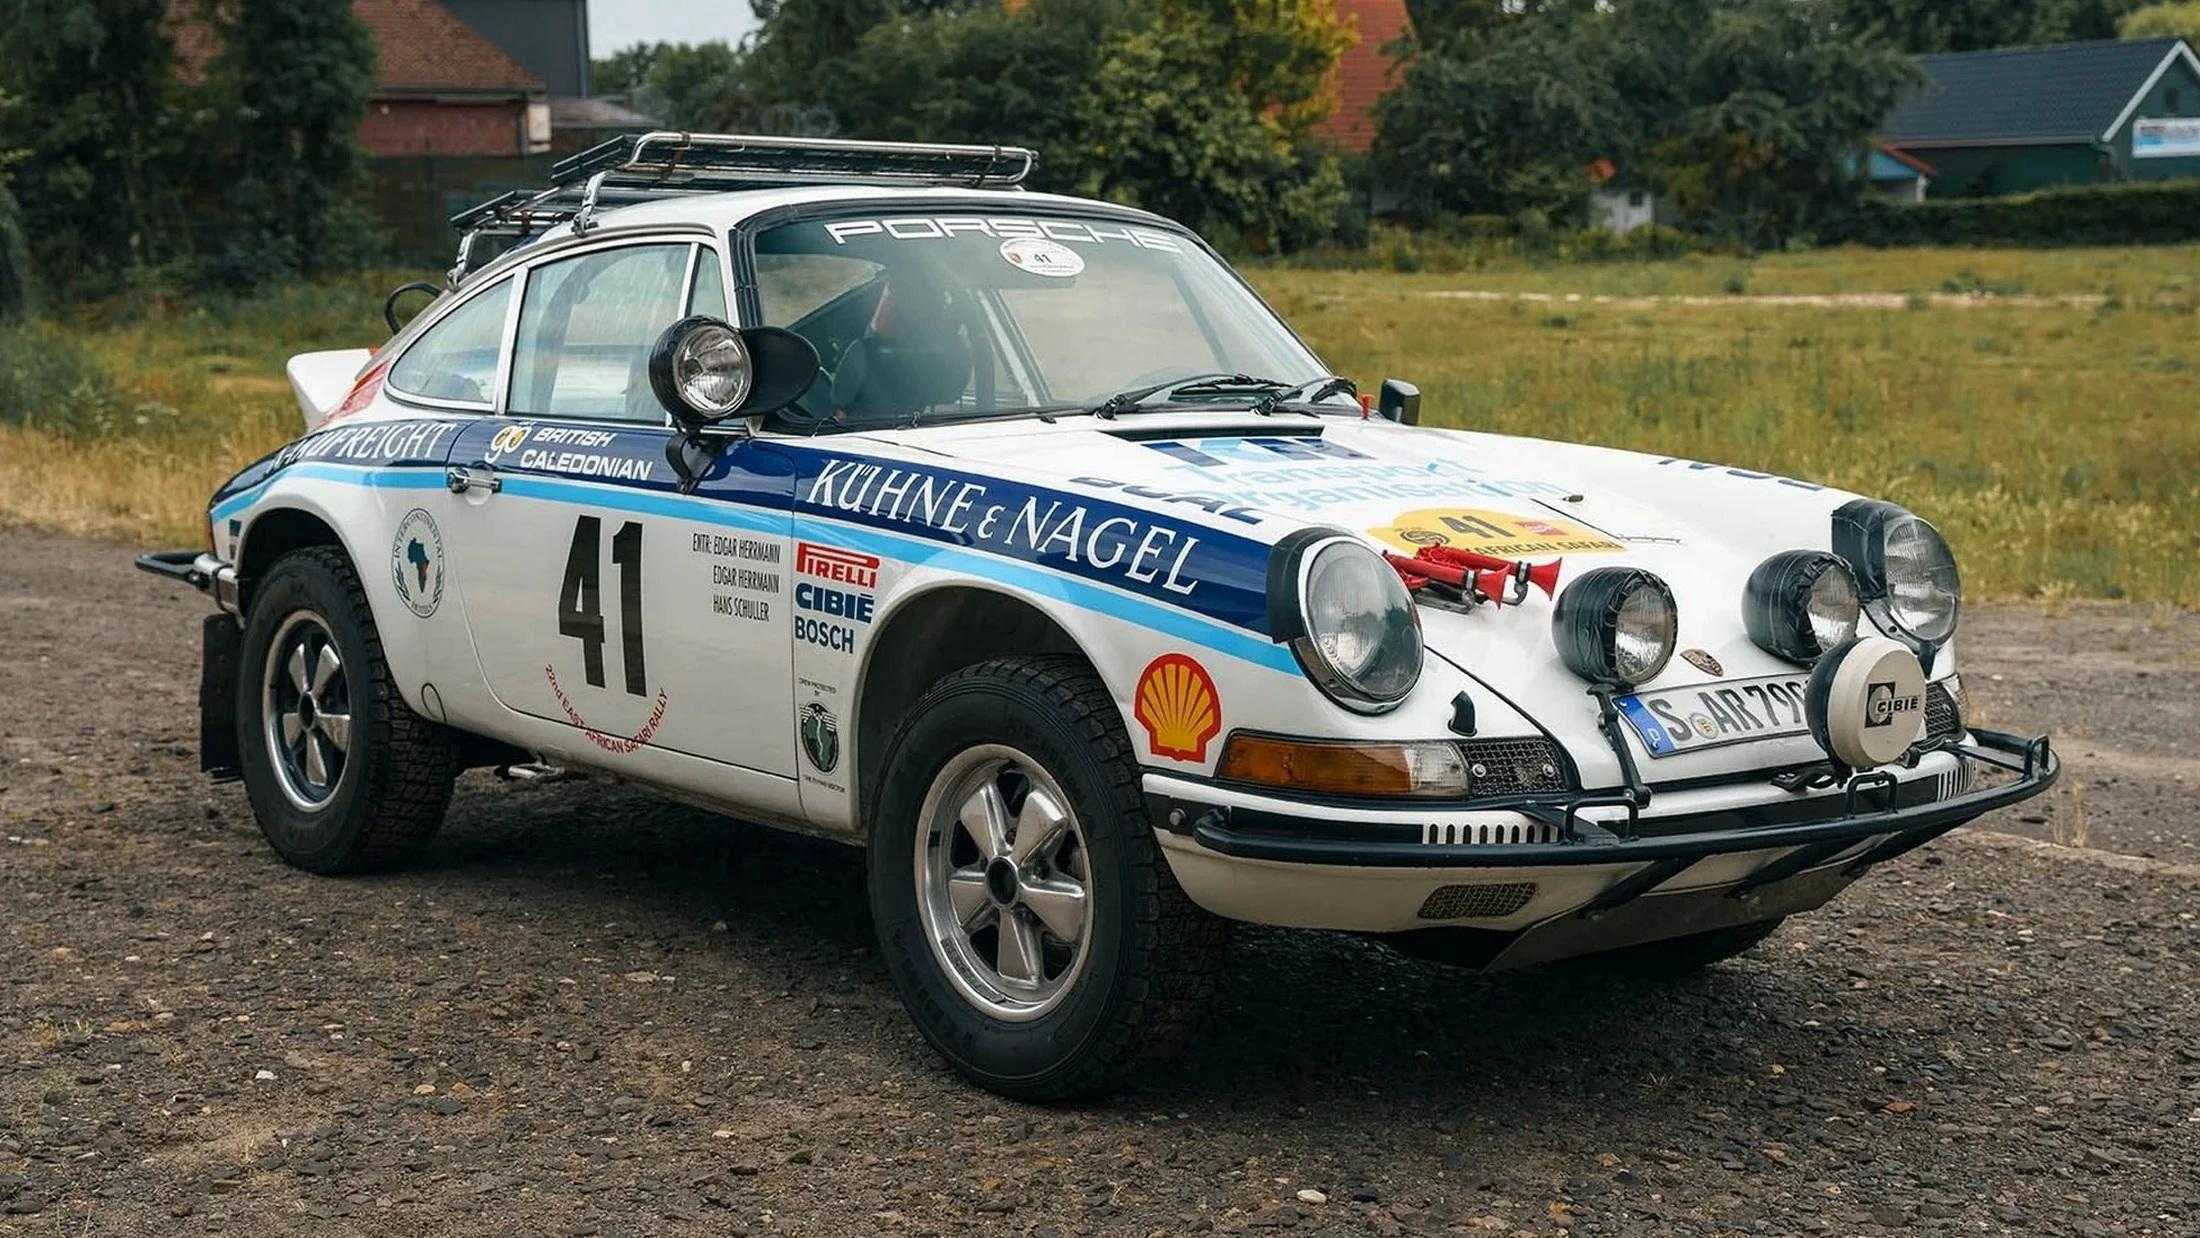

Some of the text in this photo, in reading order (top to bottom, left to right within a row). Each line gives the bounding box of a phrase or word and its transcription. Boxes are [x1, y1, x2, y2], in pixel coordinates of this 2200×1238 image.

[824, 218, 1183, 254] PORSCHE
[533, 428, 618, 447] BRITISH
[520, 449, 654, 480] CALEDONIAN
[806, 458, 986, 535] KÜHNE
[1004, 495, 1202, 596] NAGEL
[1438, 516, 1516, 538] 41
[714, 536, 738, 557] EDGAR
[739, 540, 780, 563] HERRMANN
[796, 542, 880, 589] PIRELLI
[713, 565, 780, 593] EDGAR HERRMANN
[558, 514, 647, 698] 41
[713, 593, 733, 615] HANS
[795, 615, 854, 654] BOSCH
[584, 730, 625, 753] AFRICAN
[624, 725, 651, 753] SAFARI
[648, 687, 668, 731] RALLY
[1650, 698, 1692, 741] S
